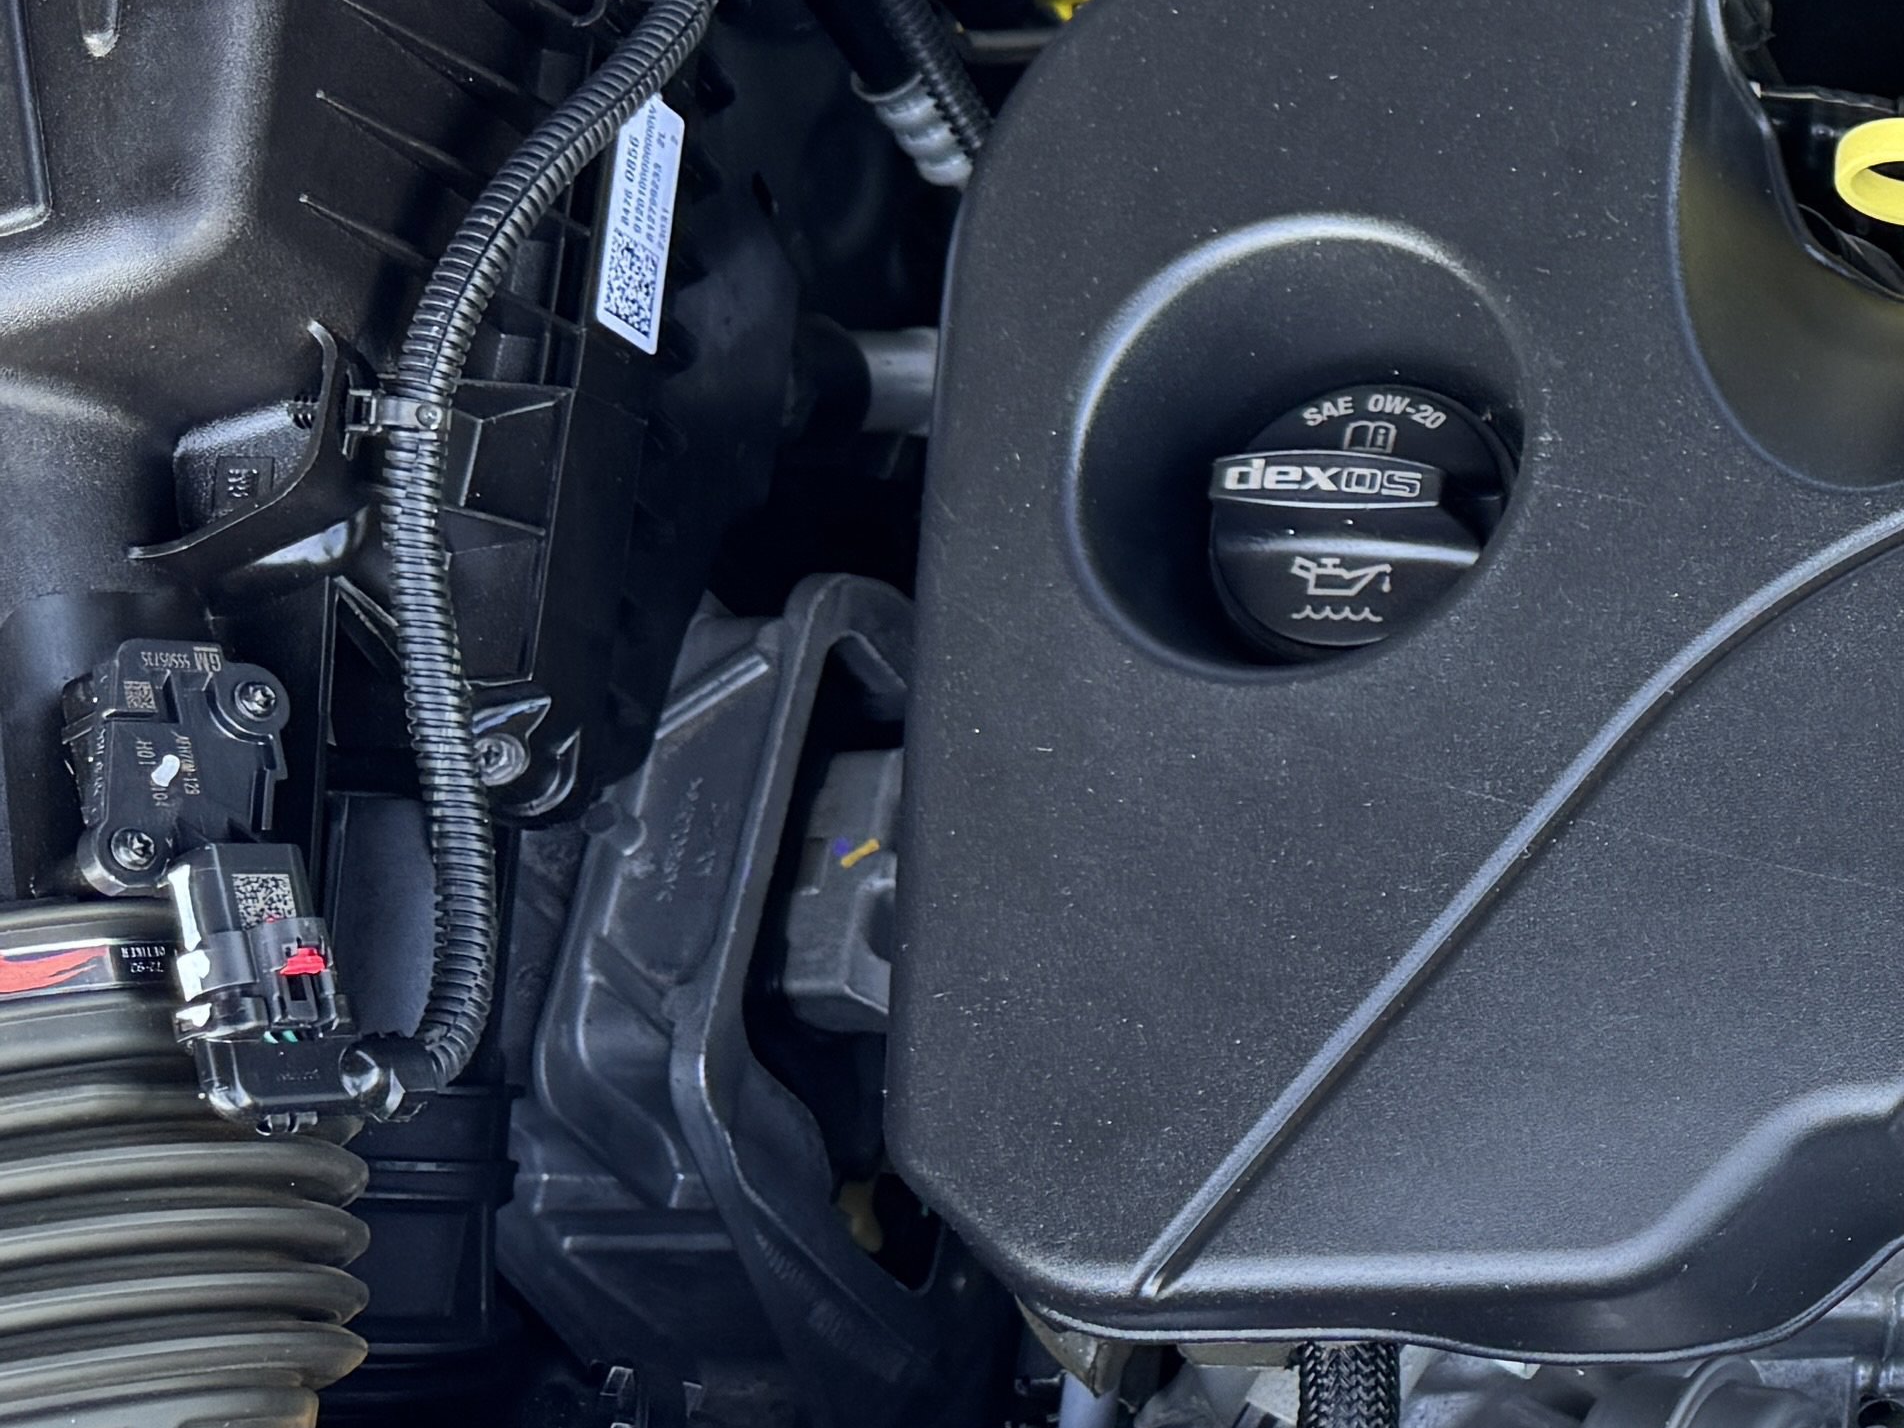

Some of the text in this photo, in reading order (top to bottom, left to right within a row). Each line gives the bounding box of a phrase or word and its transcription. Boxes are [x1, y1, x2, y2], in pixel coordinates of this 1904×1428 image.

[625, 135, 640, 183] 0856
[1303, 394, 1447, 429] SAE 0W-20
[1224, 459, 1422, 498] dexos
[193, 651, 222, 673] GM
